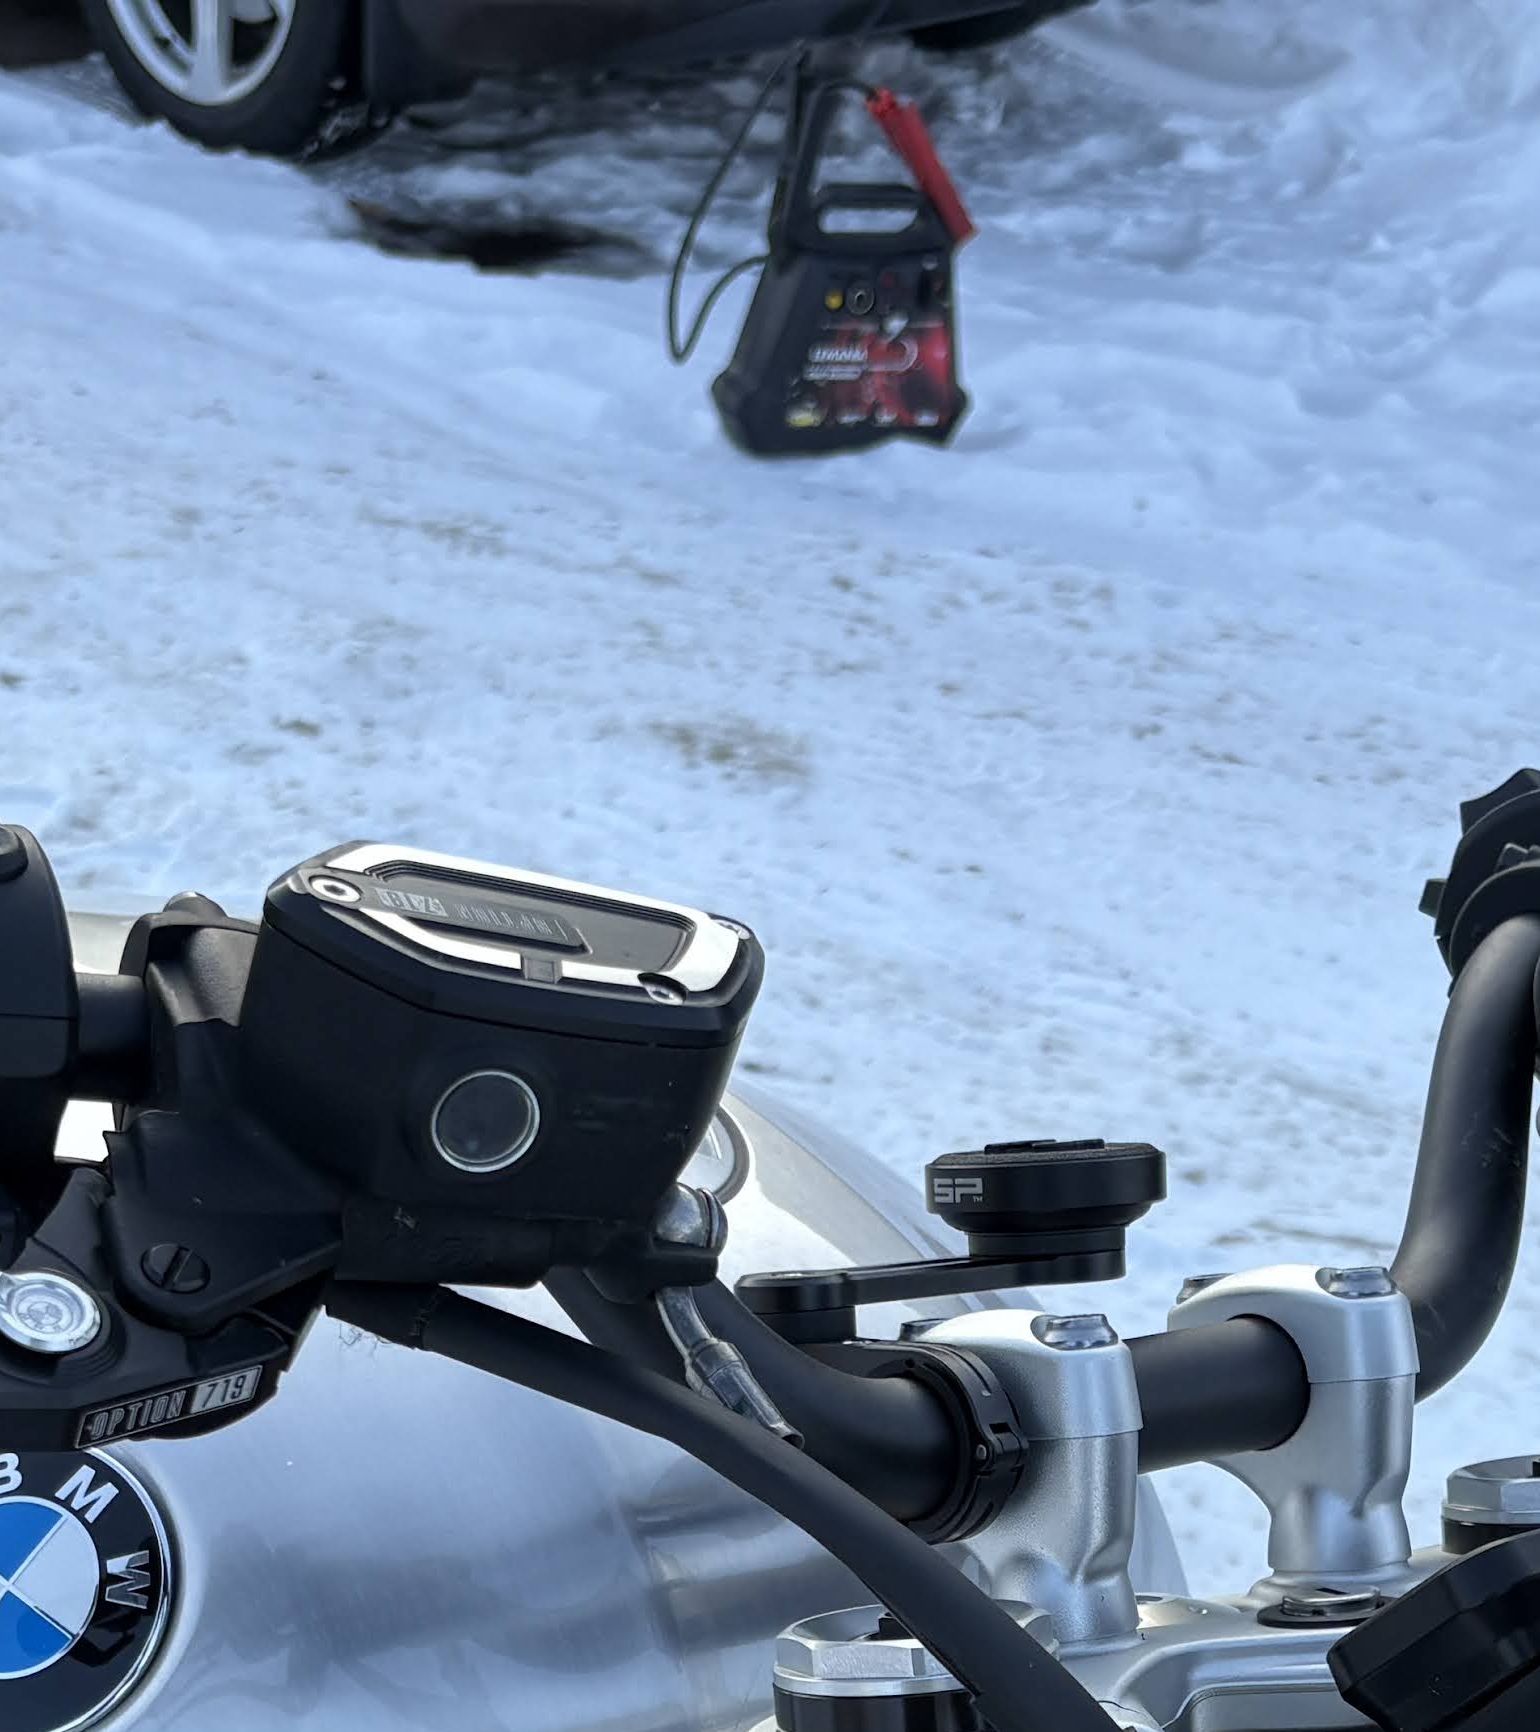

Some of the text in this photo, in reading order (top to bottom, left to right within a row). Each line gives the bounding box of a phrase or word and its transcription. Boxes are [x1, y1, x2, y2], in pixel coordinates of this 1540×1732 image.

[933, 1177, 983, 1204] SP
[90, 1374, 248, 1441] OPTION 719
